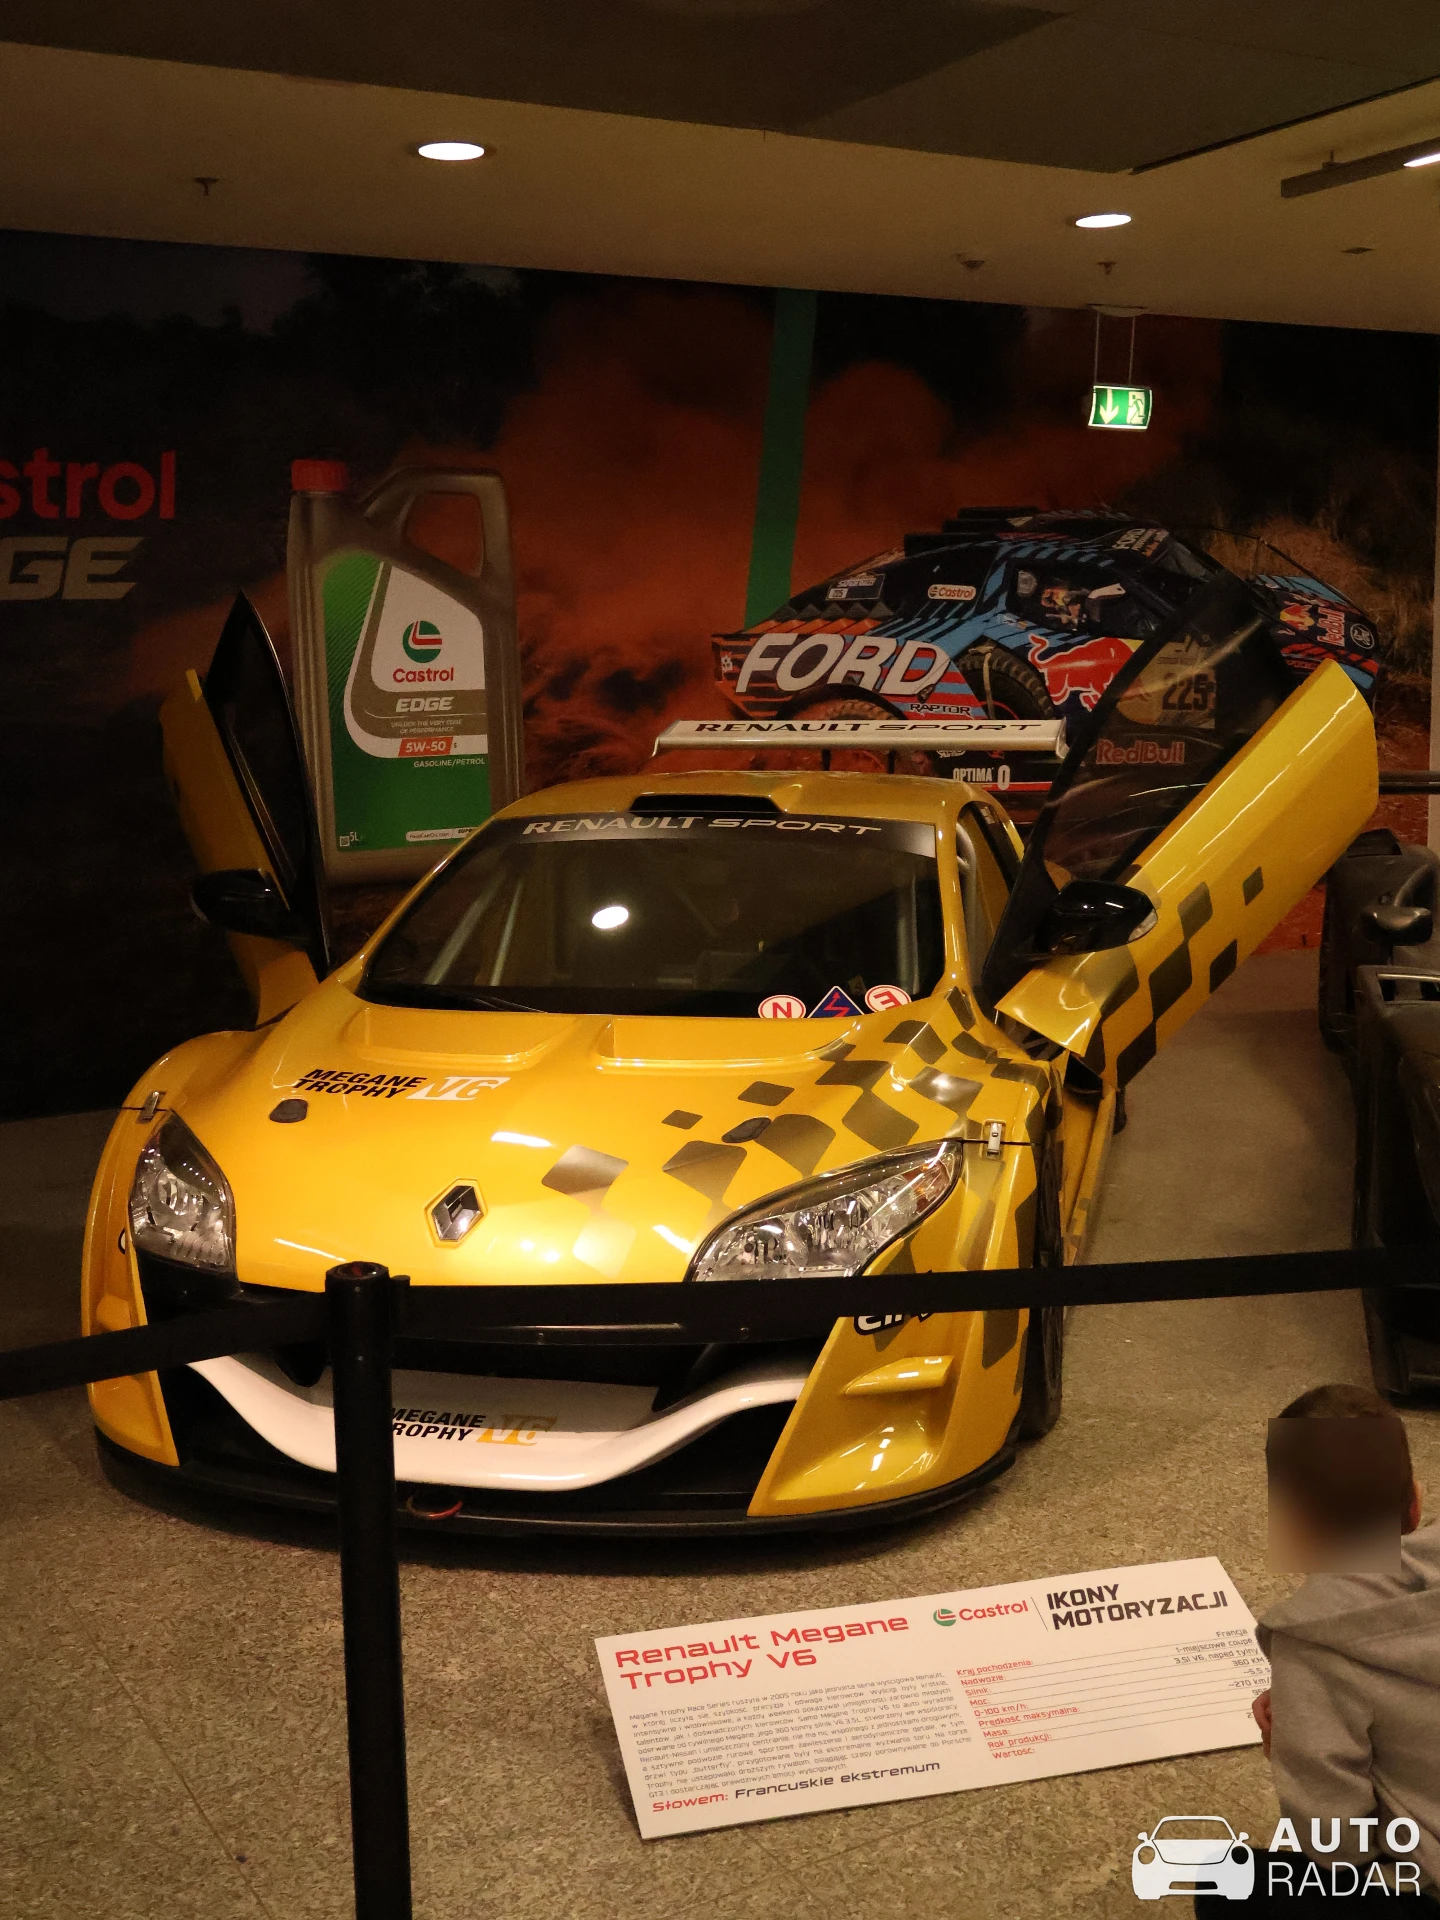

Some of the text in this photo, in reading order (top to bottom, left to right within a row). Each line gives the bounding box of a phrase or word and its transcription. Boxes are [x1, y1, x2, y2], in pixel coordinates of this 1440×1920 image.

[938, 587, 973, 599] Castrol
[736, 633, 951, 696] FORD
[392, 667, 454, 683] Castrol
[395, 697, 454, 713] EDGE
[910, 703, 971, 716] RAPTOR
[411, 725, 454, 734] PERFORMANCE
[417, 719, 429, 727] THE
[429, 718, 445, 727] VERY
[446, 718, 462, 726] EDGE
[695, 723, 1042, 733] RENAULT SPORT
[405, 739, 447, 753] 5W-50
[413, 757, 486, 769] GASOLINE/PETROL
[953, 767, 993, 782] OPTIMA
[522, 816, 881, 835] RENAULT SPORT
[292, 1079, 408, 1099] TROPHY
[304, 1068, 511, 1100] MEGANE V6
[393, 1423, 473, 1441] ROPHY
[476, 1414, 558, 1447] V6
[1047, 1584, 1119, 1610] IKONY
[959, 1600, 1029, 1621] Castrol
[1053, 1591, 1228, 1629] MOTORYZACJI
[1216, 1628, 1248, 1637] Francja
[616, 1617, 909, 1667] Renault Megane
[1176, 1642, 1226, 1653] 1-miejscowe
[1208, 1650, 1235, 1659] napęd
[621, 1648, 817, 1688] Trophy V6
[956, 1660, 1033, 1677] Kraj pochodzenia:
[1231, 1658, 1250, 1666] 360
[960, 1675, 1005, 1685] Nadwozie:
[1228, 1676, 1272, 1687] ~270 km/
[964, 1687, 992, 1696] Silnik:
[969, 1698, 990, 1706] Moc:
[974, 1703, 1029, 1716] 0-100 km/h:
[1023, 1707, 1081, 1721] maksymalna:
[983, 1729, 1011, 1737] Masa:
[987, 1733, 1052, 1748] Rok produkcji:
[653, 1762, 941, 1813] Słowem: Francuskie ekstremum
